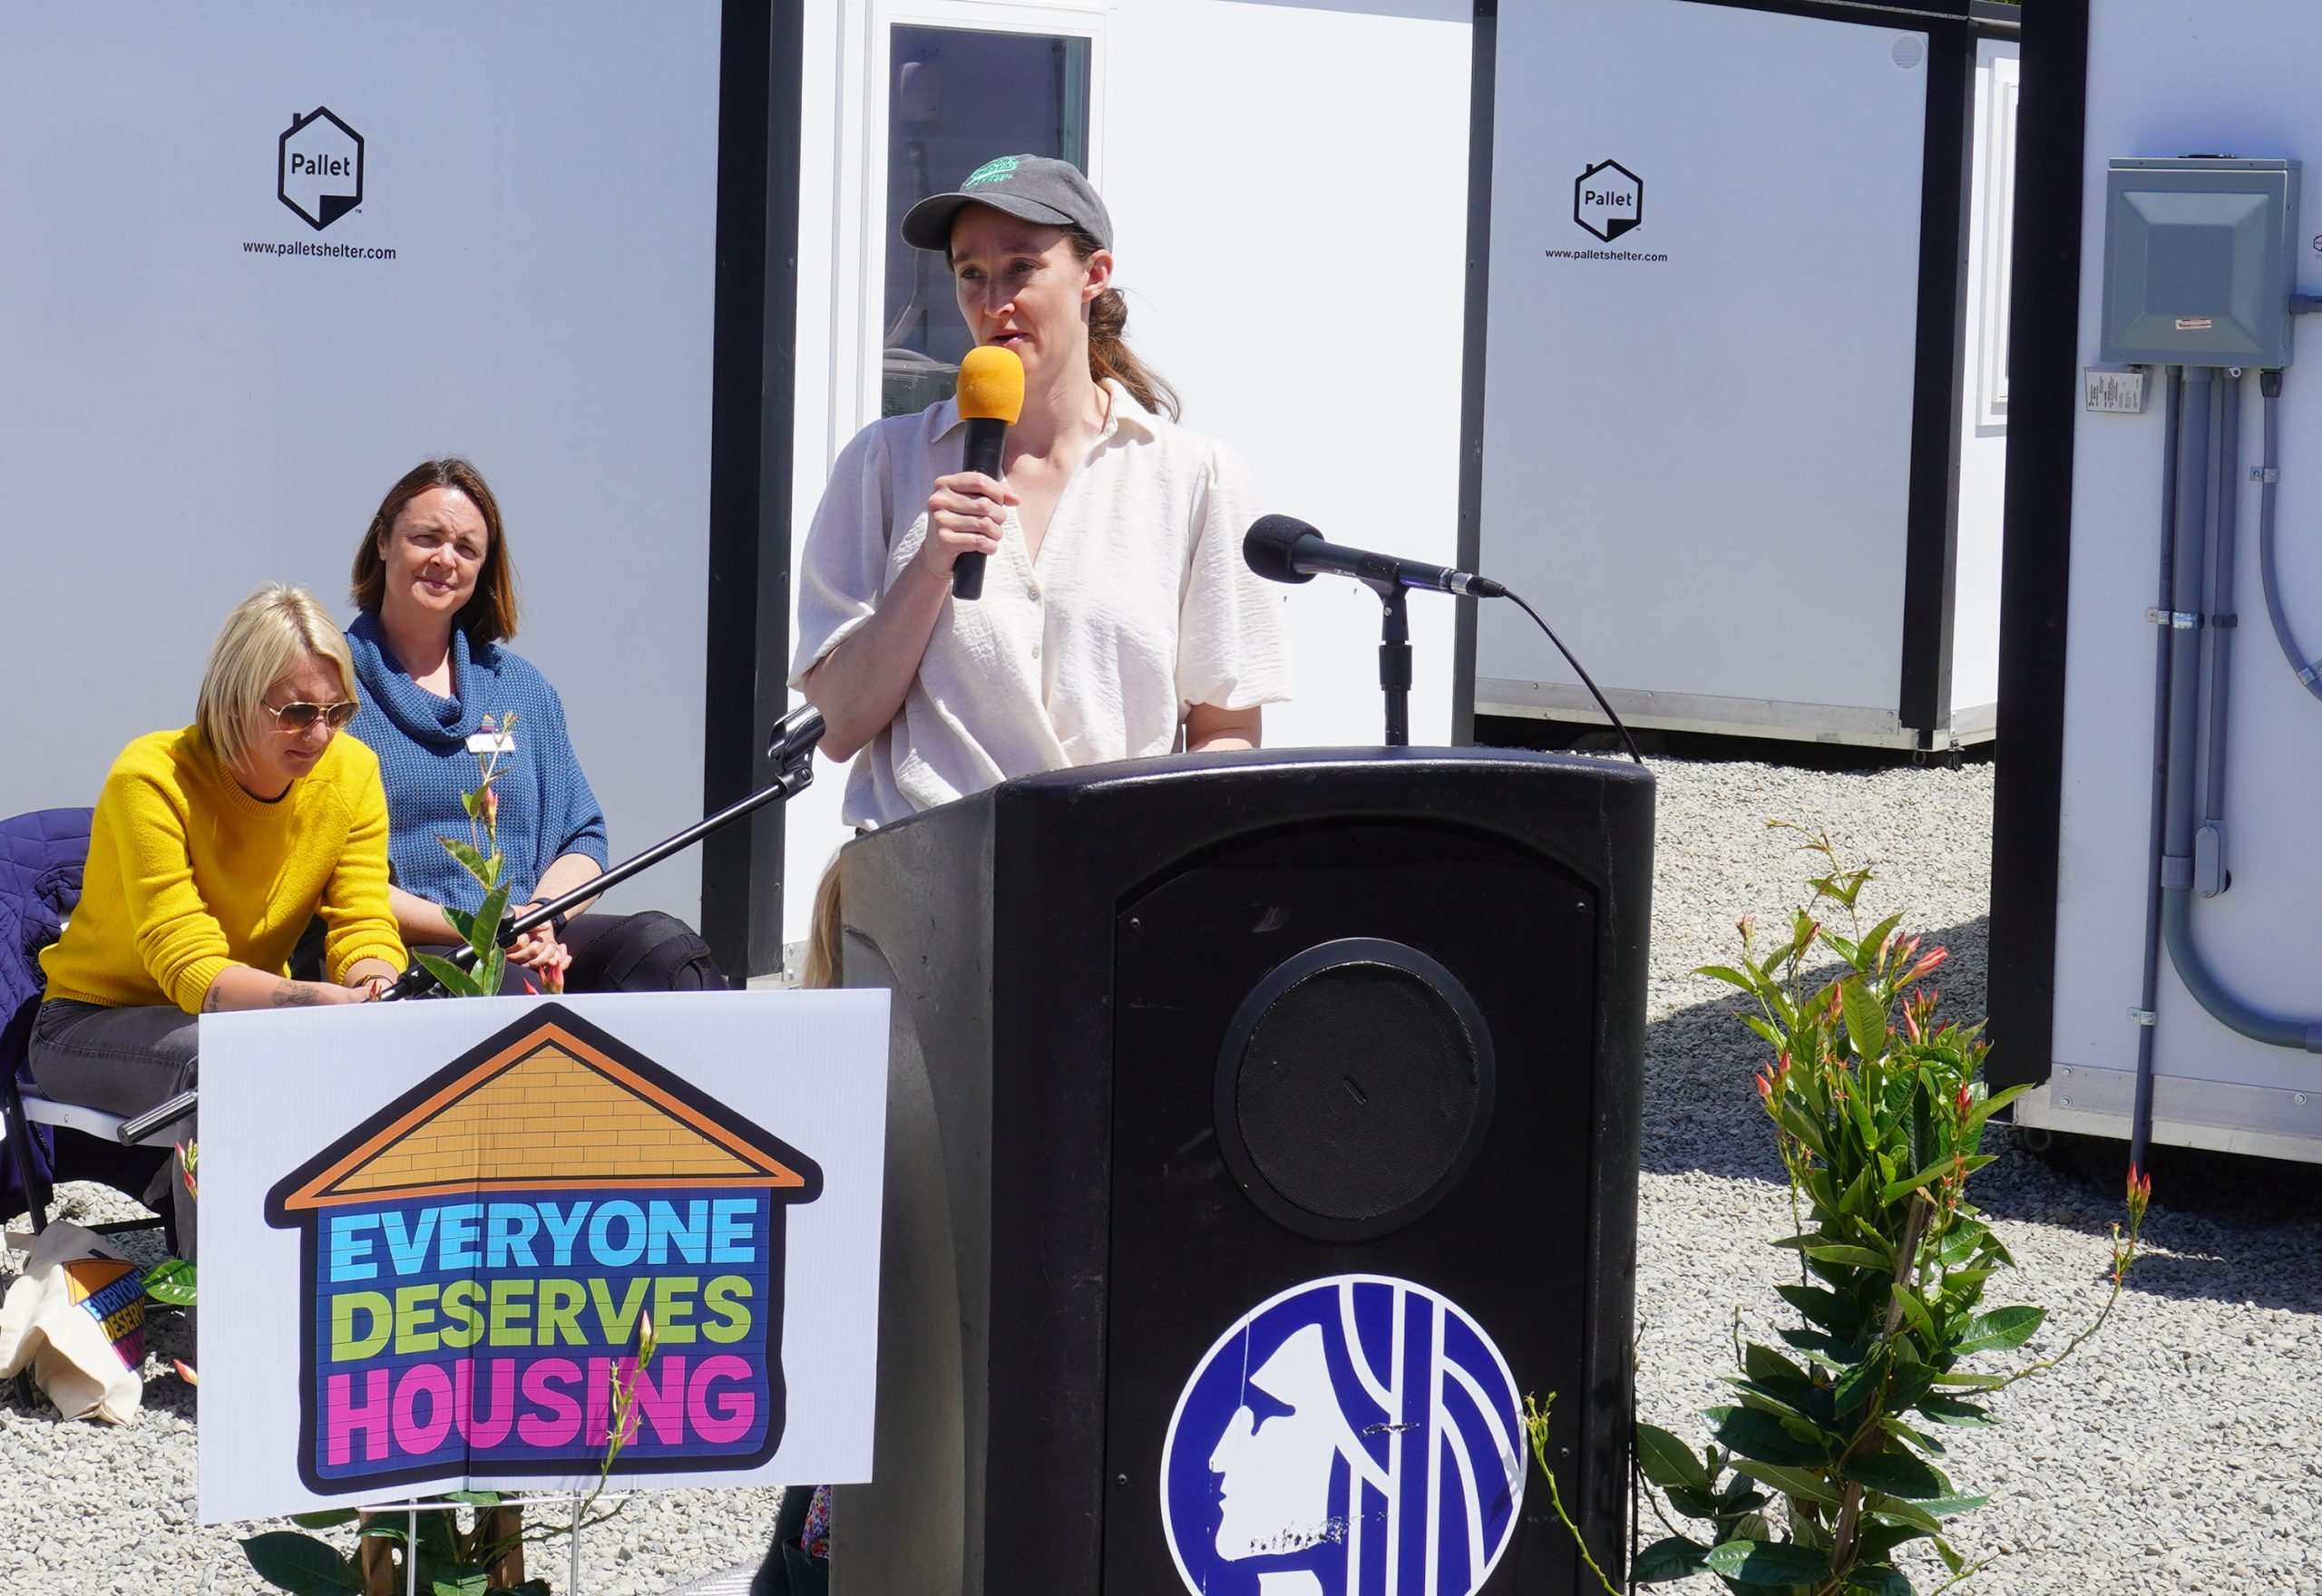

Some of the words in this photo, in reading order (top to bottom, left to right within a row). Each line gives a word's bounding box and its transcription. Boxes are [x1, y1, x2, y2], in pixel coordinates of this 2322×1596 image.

[291, 152, 350, 177] Pallet
[1585, 190, 1632, 207] Pallet
[242, 241, 396, 259] www.palletshelter.com
[1545, 249, 1668, 262] www.palletshelter.com
[329, 1199, 756, 1282] EVERYONE
[331, 1275, 753, 1362] DESERVES
[327, 1355, 756, 1465] HOUSING
